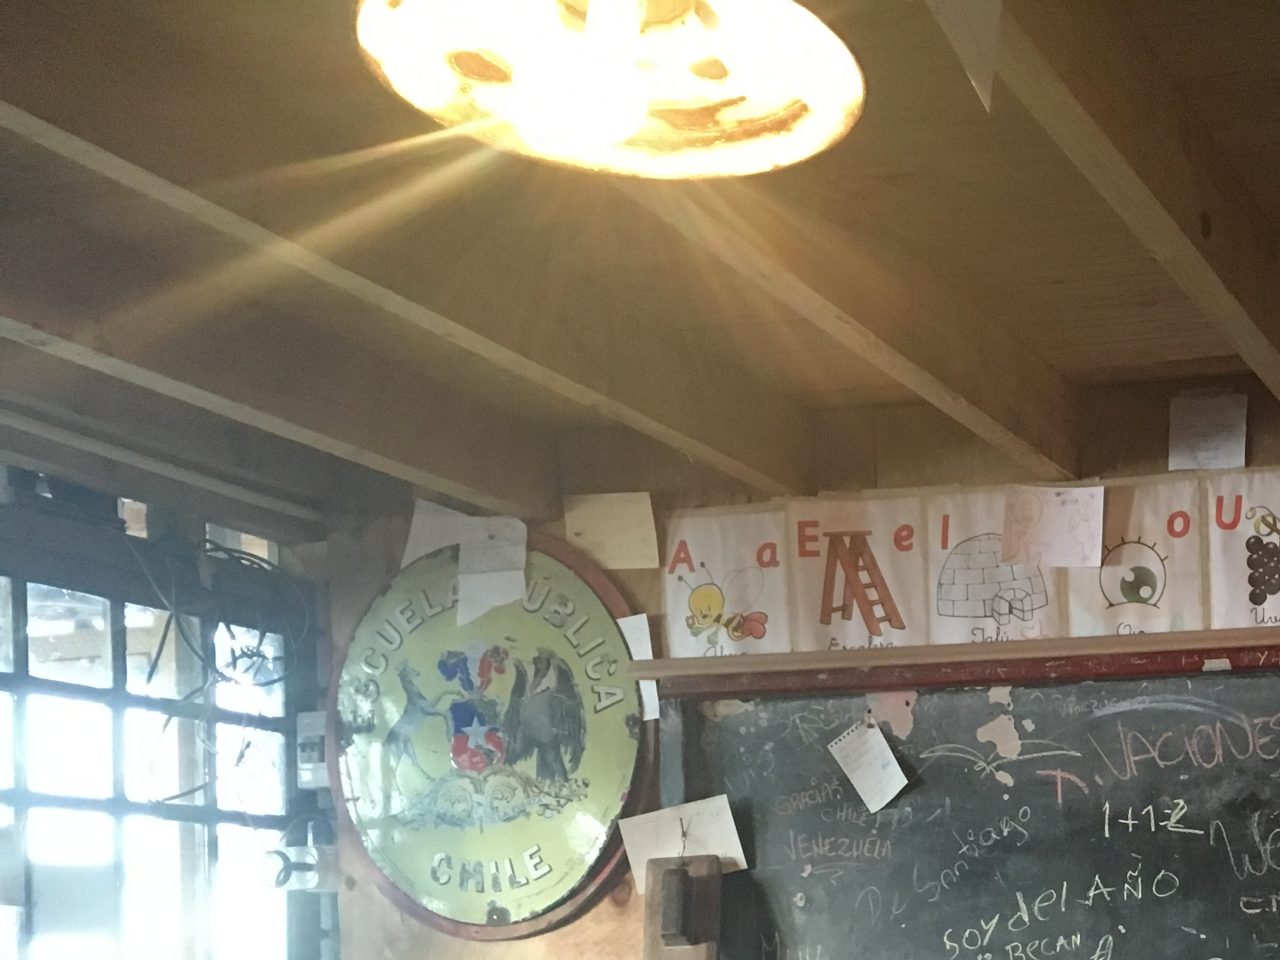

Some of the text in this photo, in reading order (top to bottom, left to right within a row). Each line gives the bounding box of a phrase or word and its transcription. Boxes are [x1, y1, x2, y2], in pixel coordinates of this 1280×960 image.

[1215, 495, 1243, 530] U
[668, 539, 780, 574] A a
[797, 520, 914, 557] E e
[521, 575, 626, 714] ÚBLICA
[429, 843, 553, 894] CHILE
[1008, 881, 1068, 932] del
